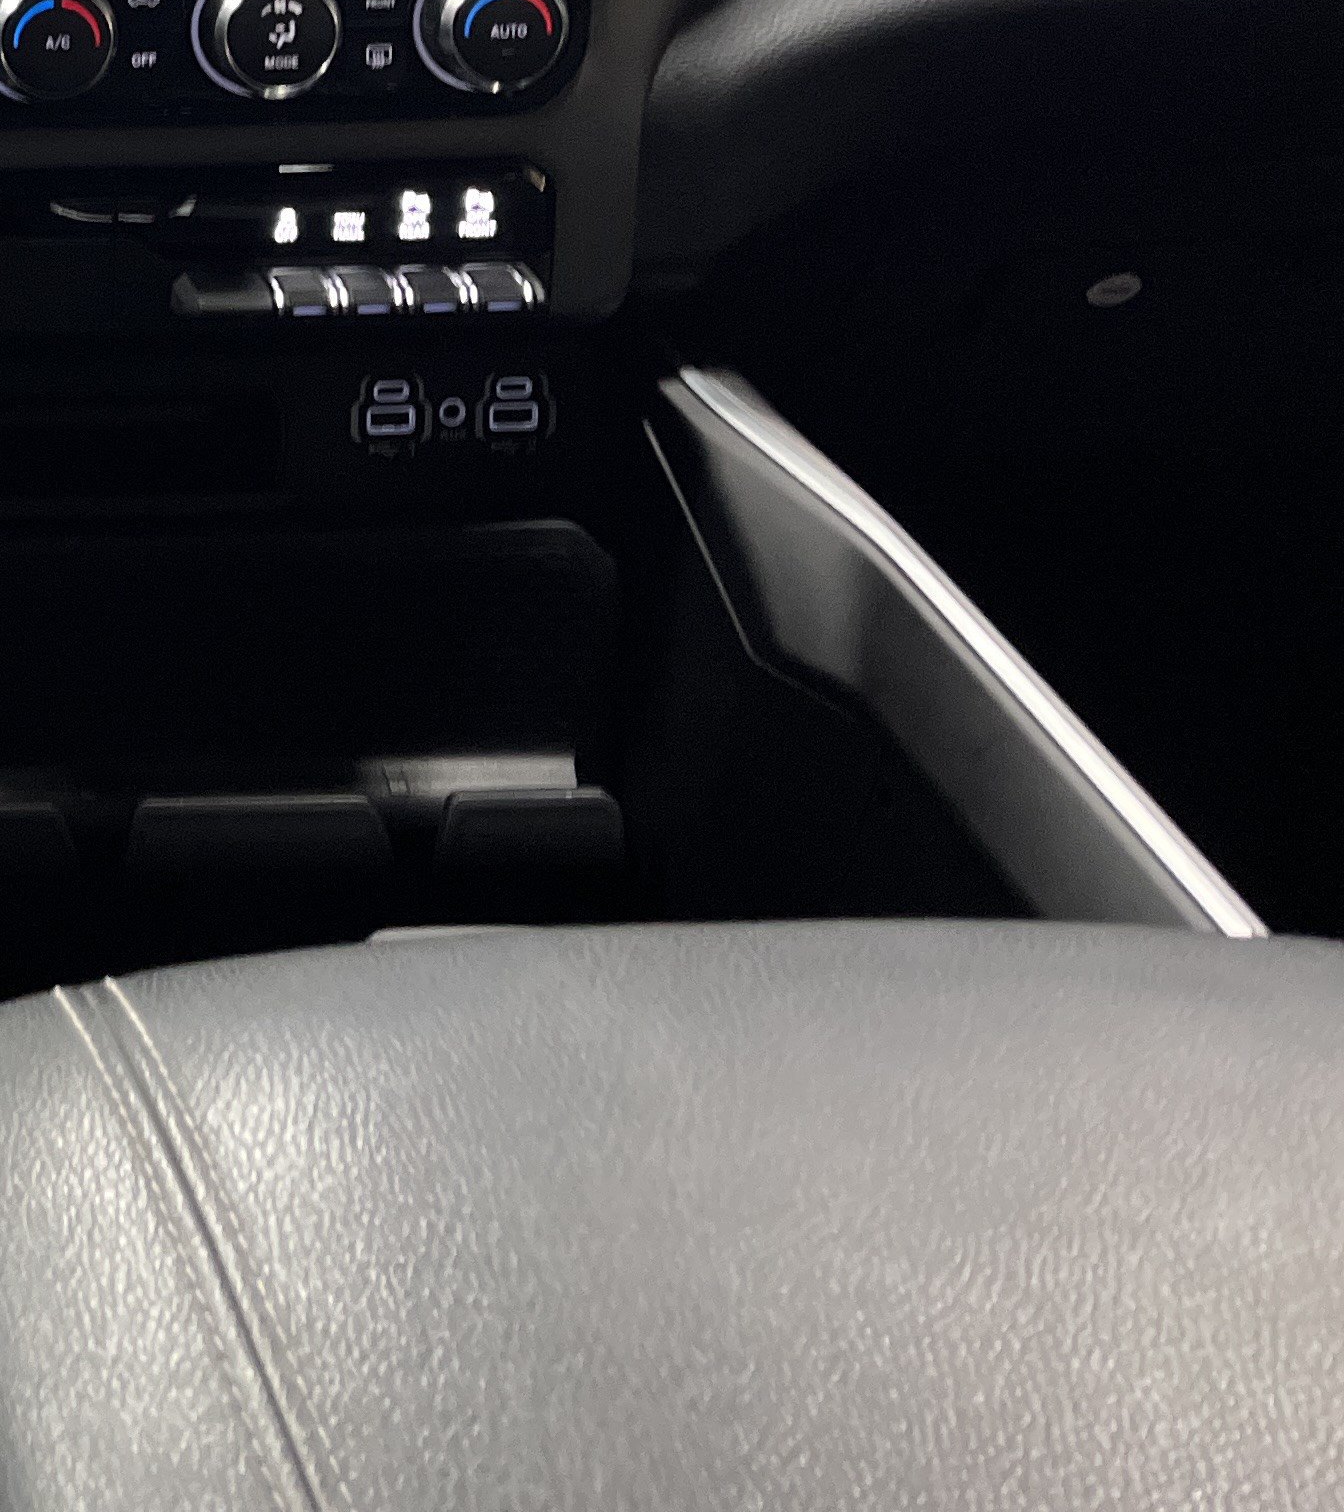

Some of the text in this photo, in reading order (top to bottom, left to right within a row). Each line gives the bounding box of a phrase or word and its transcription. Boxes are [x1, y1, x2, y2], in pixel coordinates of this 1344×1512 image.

[490, 22, 528, 40] AUTO
[45, 34, 71, 51] A/C
[131, 50, 157, 68] OFF
[264, 54, 299, 71] MODE
